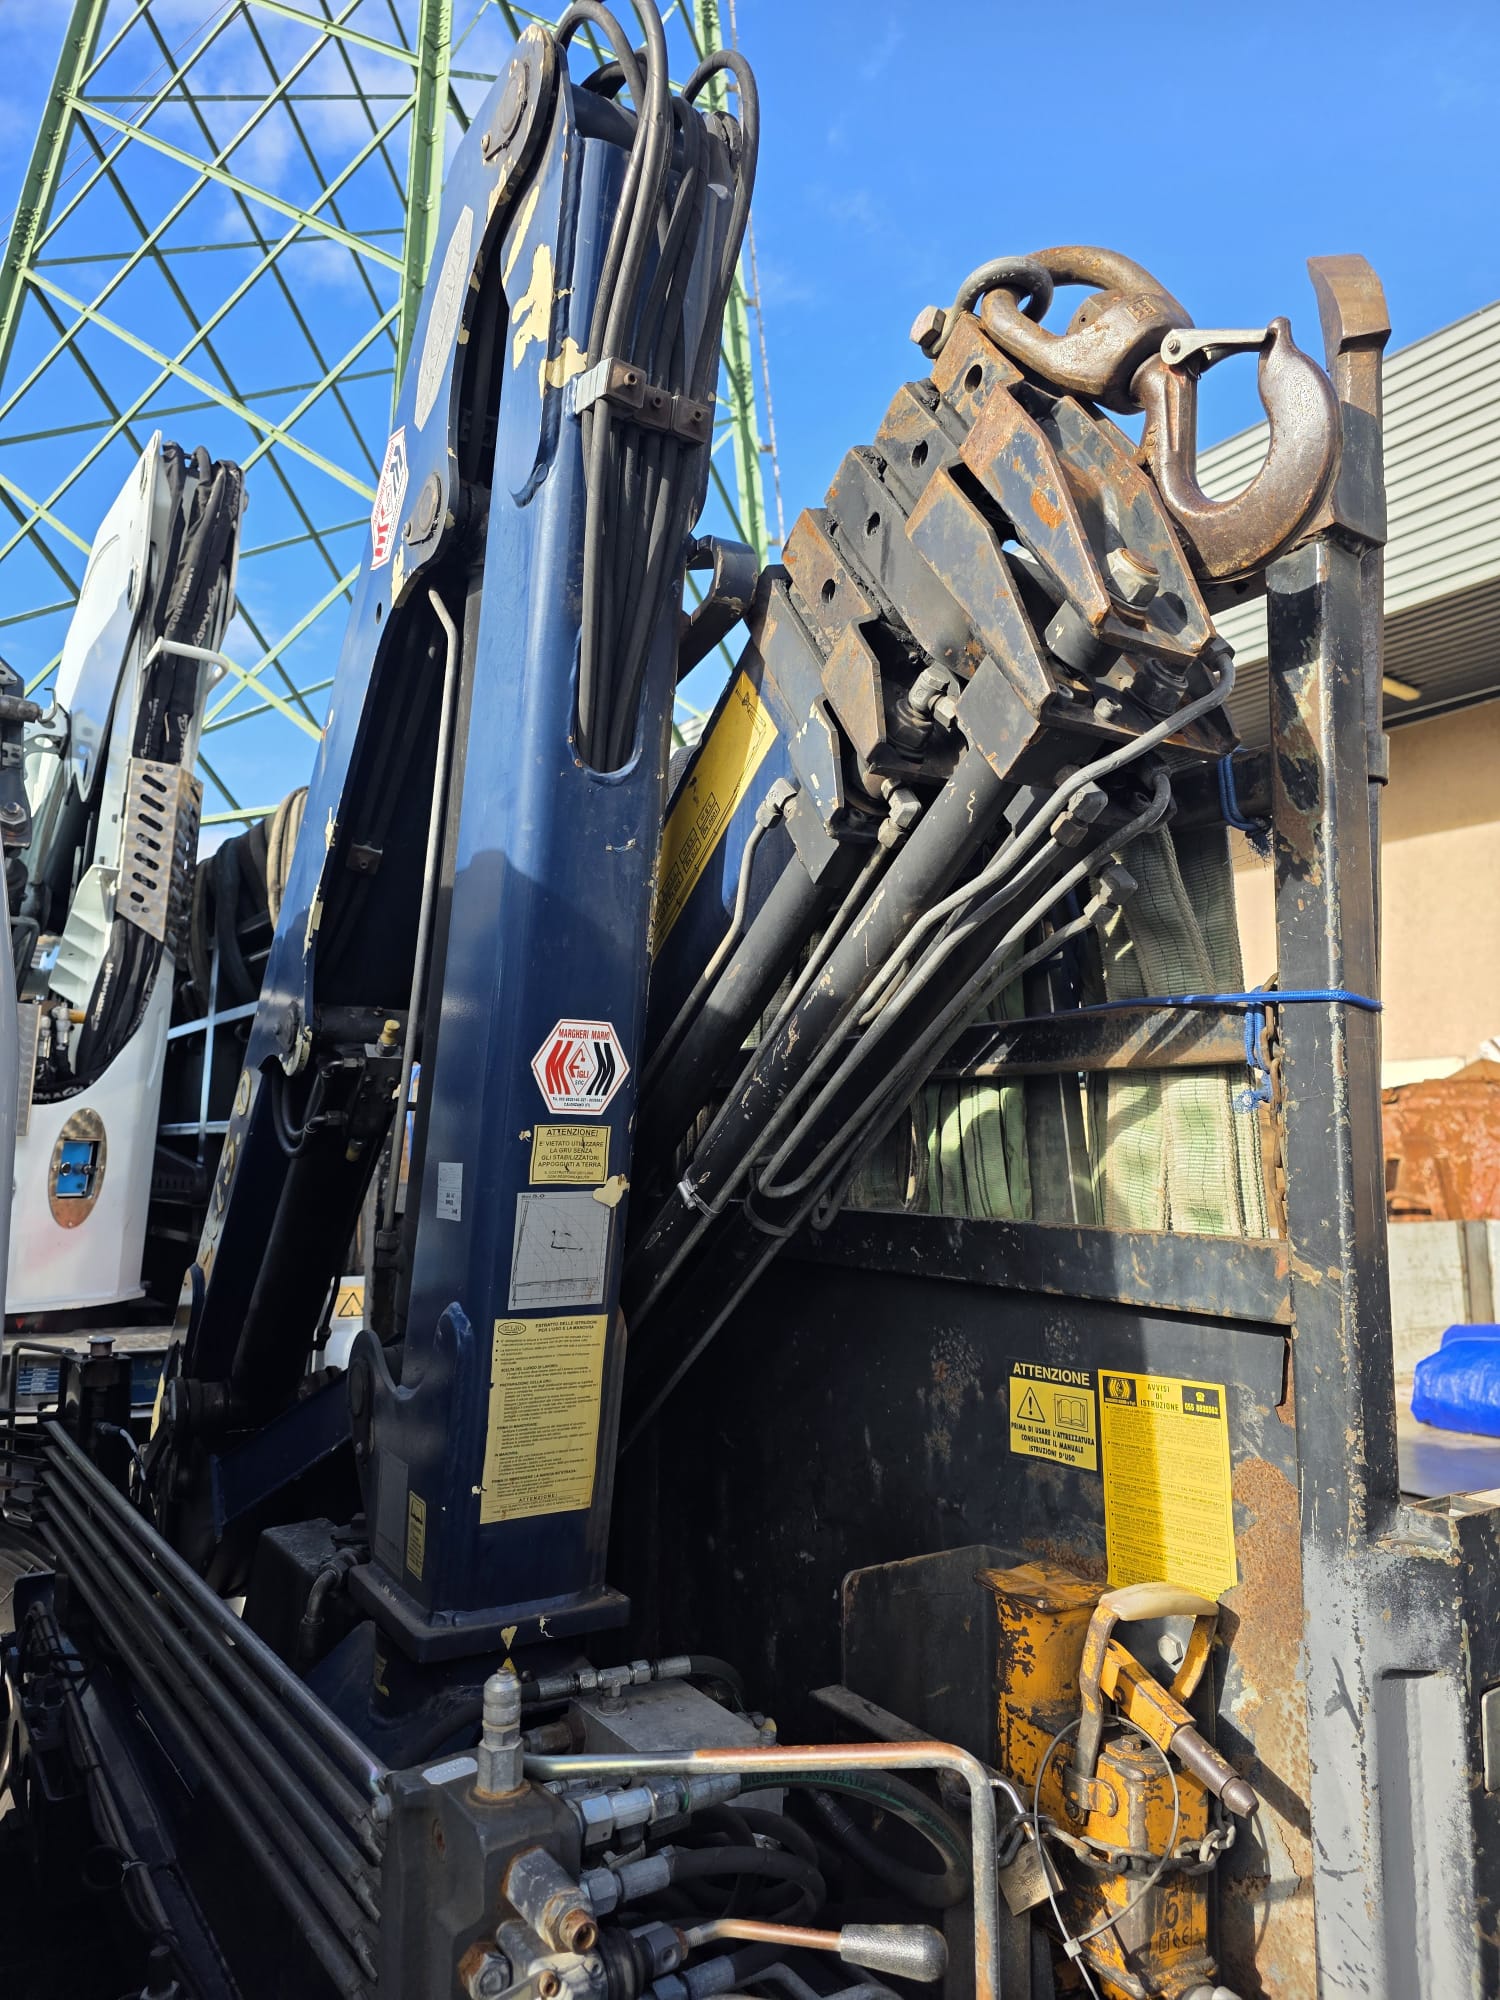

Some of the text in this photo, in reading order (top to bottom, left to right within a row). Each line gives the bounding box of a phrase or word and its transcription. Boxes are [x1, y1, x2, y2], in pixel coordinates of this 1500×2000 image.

[558, 1028, 610, 1040] MARGHERI MARIO
[546, 1129, 599, 1137] ATTENZIONE!
[1013, 1362, 1090, 1386] ATTENZIONE
[1147, 1383, 1170, 1393] AVVISI
[1155, 1392, 1162, 1400] DI
[1140, 1399, 1180, 1412] ISTRUZIONE
[1011, 1422, 1026, 1430] PRIMA
[1035, 1428, 1051, 1436] USARE
[1052, 1430, 1095, 1446] L'ATTREZZATURA
[1021, 1435, 1051, 1445] CONSULTARE
[1059, 1442, 1083, 1453] MANUALE
[1029, 1445, 1075, 1462] ISTRUZIONI D'USO
